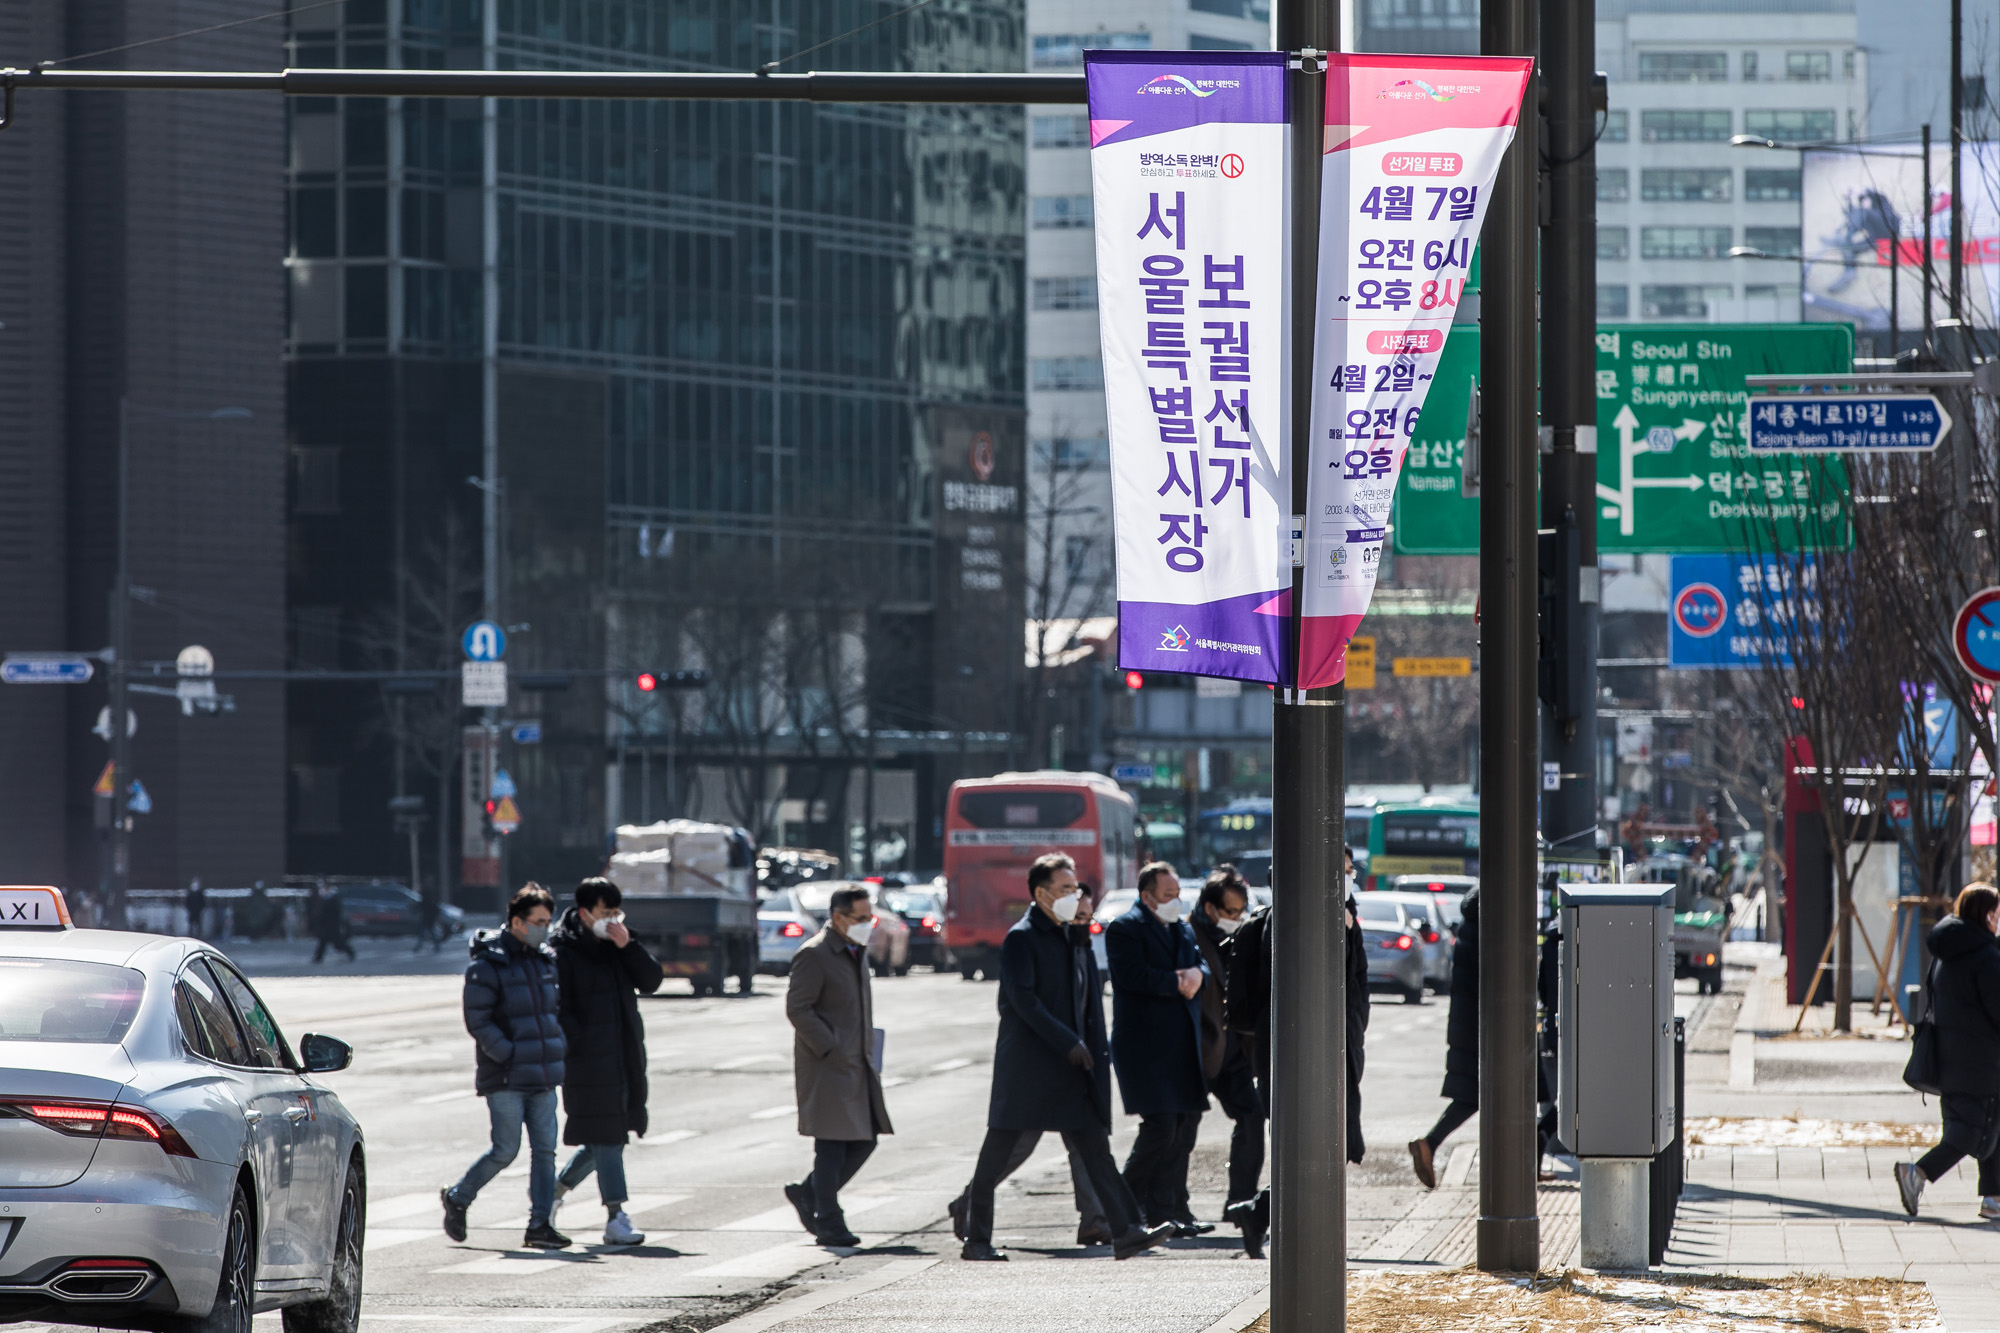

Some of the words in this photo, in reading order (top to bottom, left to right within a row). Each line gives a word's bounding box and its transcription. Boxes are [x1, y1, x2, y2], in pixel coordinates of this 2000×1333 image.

[1148, 86, 1173, 95] 아름다운
[1174, 86, 1187, 95] 선거
[1215, 80, 1240, 89] 대한민국
[1414, 92, 1426, 100] 선거
[1140, 153, 1188, 167] 방역소독
[1190, 154, 1219, 168] 완벽!
[1389, 157, 1426, 172] 선거일
[1429, 157, 1455, 172] 투표
[1140, 167, 1175, 177] 안심하고
[1176, 169, 1218, 179] 투표하세요.
[1359, 186, 1414, 221] 4월
[1425, 185, 1478, 222] 7일
[1358, 239, 1415, 271] 오전
[1423, 238, 1469, 271] 6시
[1419, 277, 1466, 311] 8시
[1381, 334, 1430, 350] 사전투표
[1631, 340, 1688, 360] Seoul
[1696, 340, 1732, 360] Stn
[1136, 191, 1209, 573] 서울특별시장
[1198, 255, 1252, 519] 보궐선거
[1330, 364, 1367, 392] 4월
[1631, 386, 1748, 409] Sungnyemun
[1329, 429, 1342, 440] 매일
[1345, 407, 1398, 440] 오전
[1756, 402, 1888, 428] 세종대로19길
[1407, 472, 1456, 491] Namsan
[1709, 470, 1812, 499] 덕수궁길
[1194, 638, 1262, 656] 서울특별시선거관리위원회
